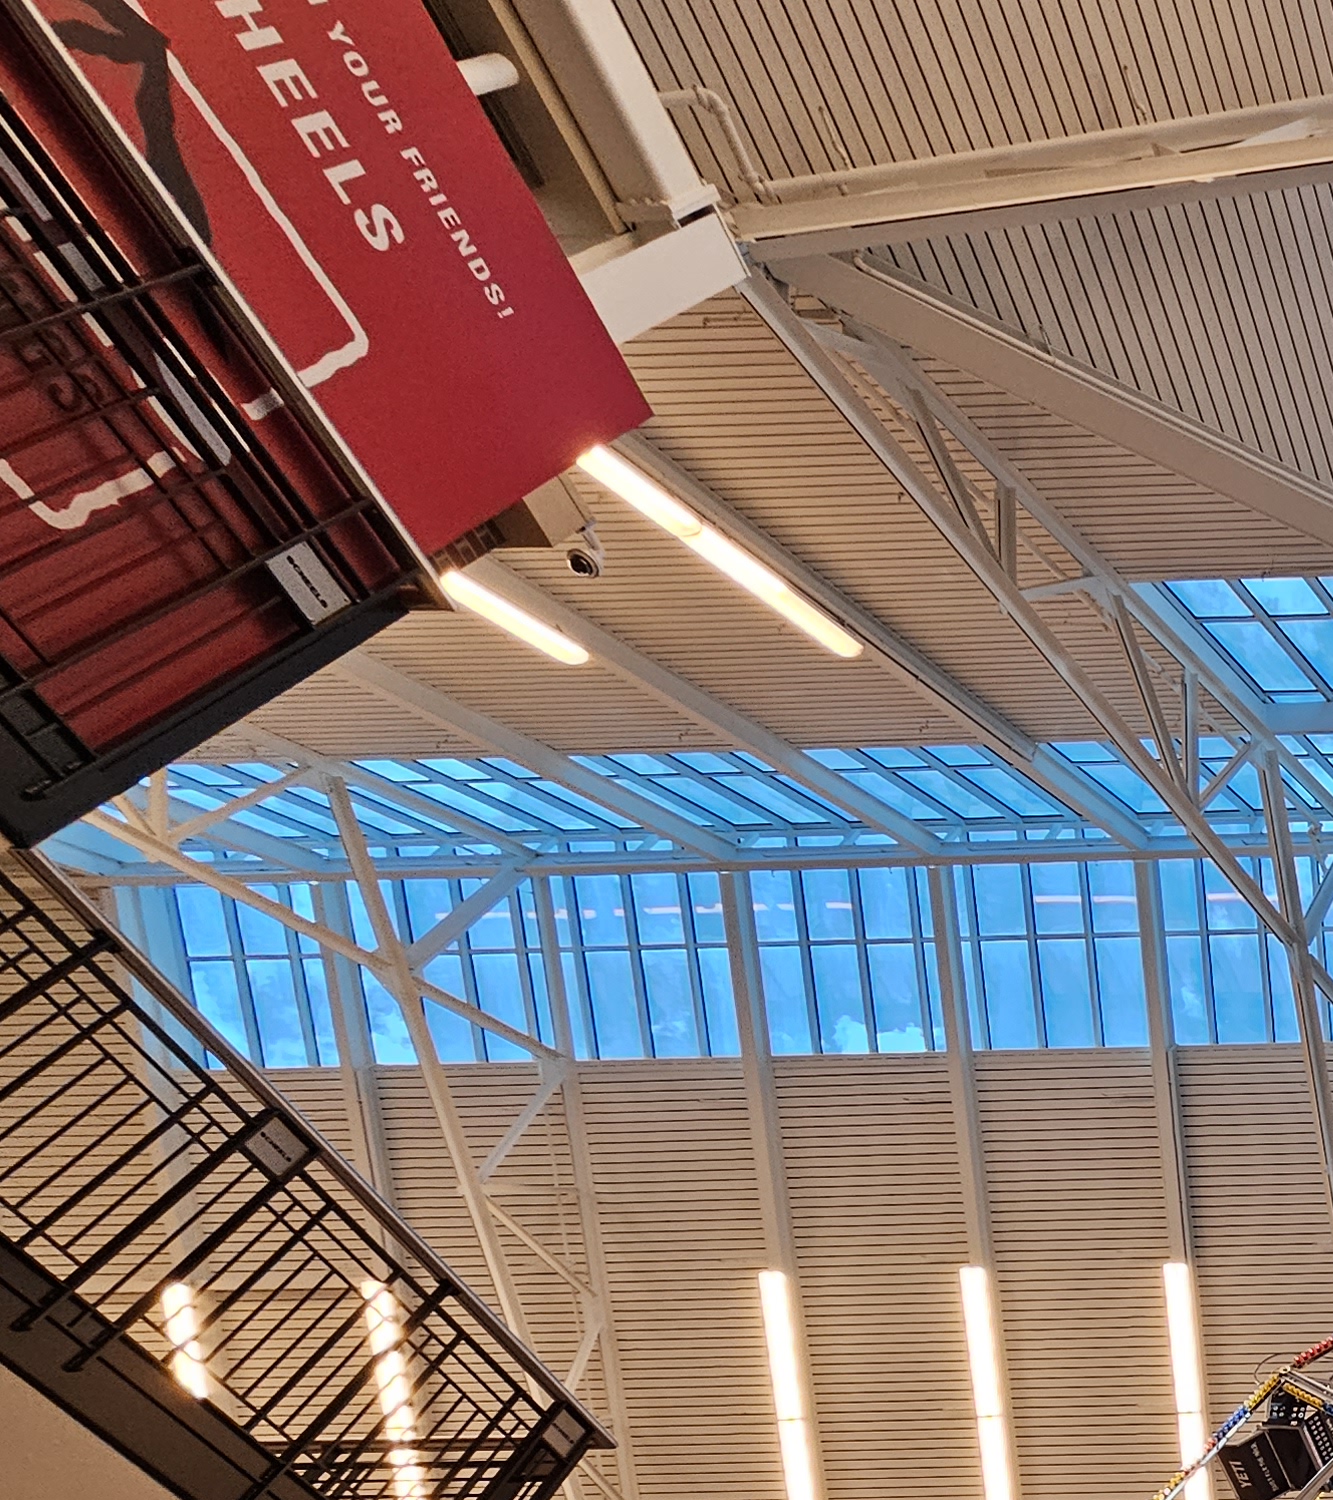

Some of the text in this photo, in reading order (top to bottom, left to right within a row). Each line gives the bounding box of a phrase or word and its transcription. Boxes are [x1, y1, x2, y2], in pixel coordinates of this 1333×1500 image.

[327, 19, 515, 319] YOUR FRIENDS!
[1228, 1460, 1254, 1489] YETI
